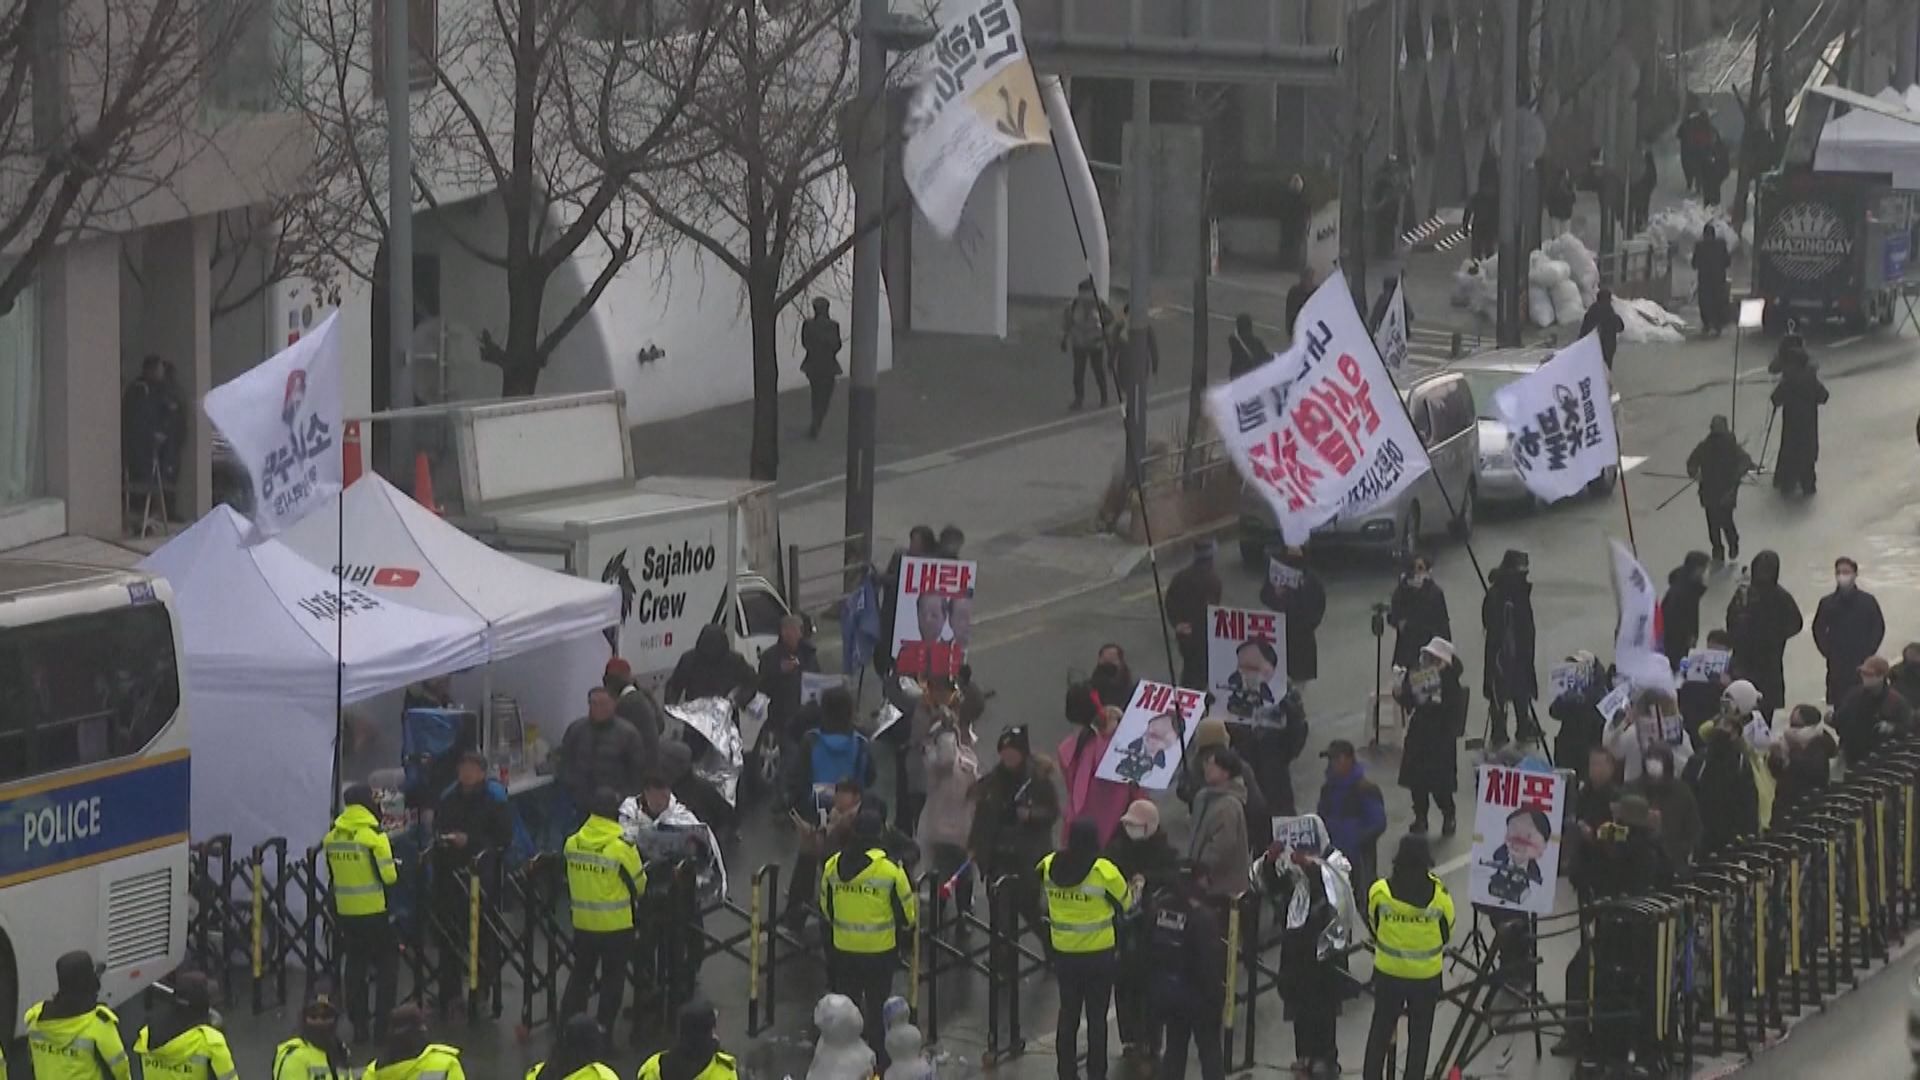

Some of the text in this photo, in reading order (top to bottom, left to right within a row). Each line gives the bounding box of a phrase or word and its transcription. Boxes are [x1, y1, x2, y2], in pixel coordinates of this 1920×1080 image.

[1761, 238, 1853, 254] AMAZINGDAY
[642, 540, 715, 588] Sajahoo
[904, 563, 974, 599] 내란
[640, 588, 686, 624] Crew
[1214, 608, 1277, 643] 체포
[1485, 768, 1554, 812] 체포
[23, 797, 101, 851] POLICE
